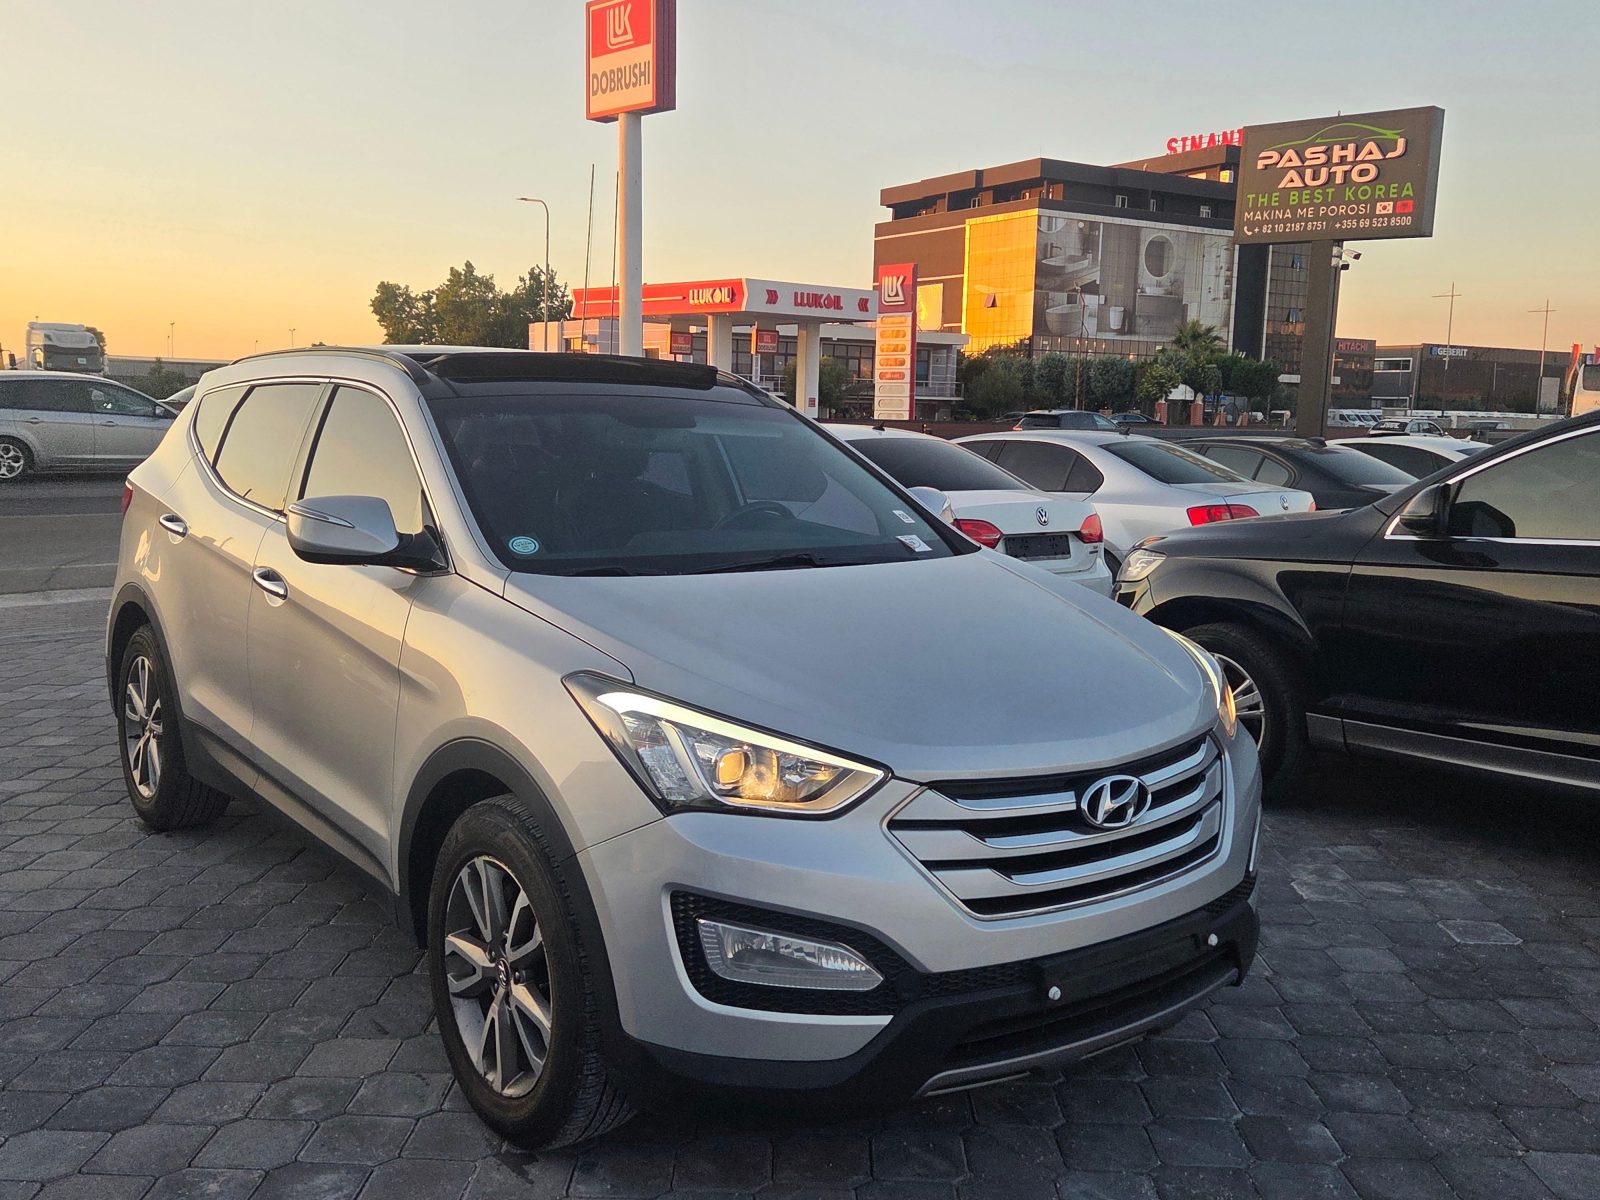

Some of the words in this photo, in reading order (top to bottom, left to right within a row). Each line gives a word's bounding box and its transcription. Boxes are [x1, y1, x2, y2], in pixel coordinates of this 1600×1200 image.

[591, 60, 651, 97] DOBRUSHI
[1257, 137, 1407, 170] PASHAJ
[1277, 163, 1379, 189] AUTO
[1247, 192, 1280, 208] THE
[1289, 188, 1336, 205] BEST
[1345, 182, 1414, 201] KOREA
[1244, 208, 1292, 222] MAKINA
[1297, 207, 1315, 218] ME
[1319, 203, 1371, 217] POROSI
[1275, 223, 1284, 233] 10
[1286, 222, 1306, 232] 2187
[1307, 221, 1327, 231] 8751
[1335, 218, 1357, 230] +355
[1360, 218, 1370, 228] 69
[1372, 217, 1388, 228] 523
[1390, 215, 1412, 227] 8500
